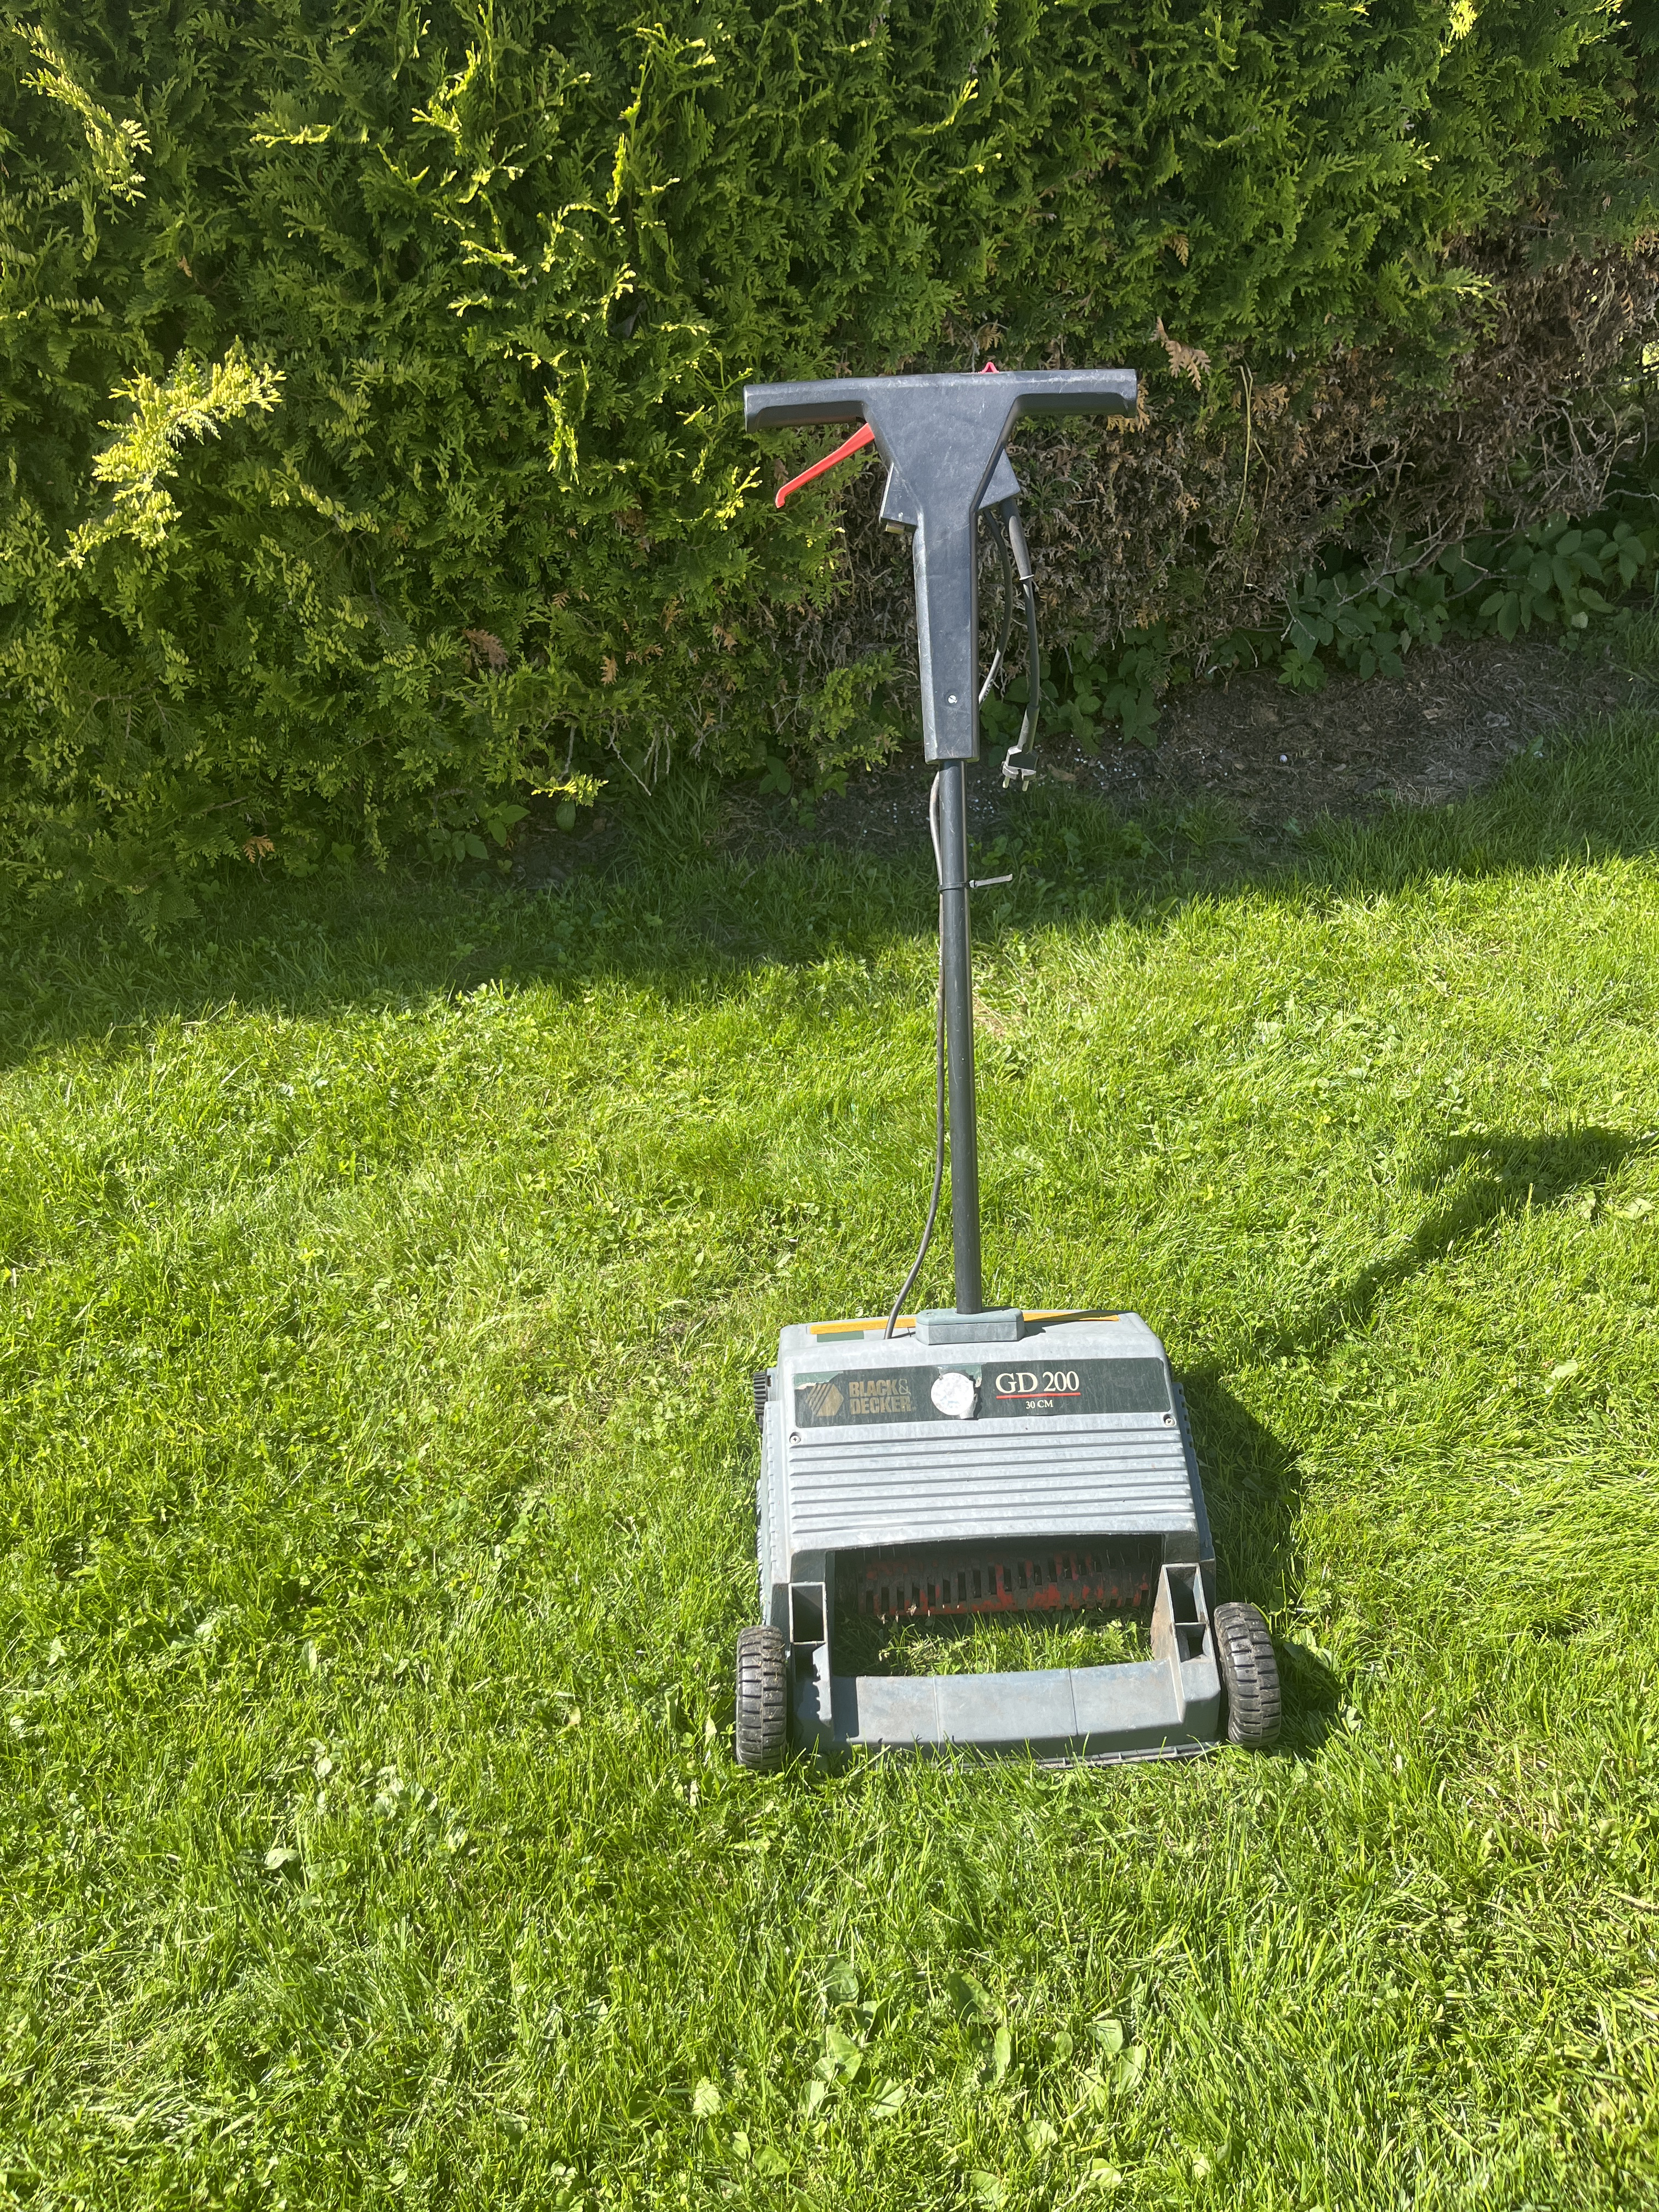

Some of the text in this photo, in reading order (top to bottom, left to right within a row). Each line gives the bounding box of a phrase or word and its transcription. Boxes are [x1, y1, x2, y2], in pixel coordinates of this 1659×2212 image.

[996, 1371, 1080, 1393] GD 200
[850, 1396, 911, 1415] DECKER
[1025, 1400, 1054, 1409] 30 CM
